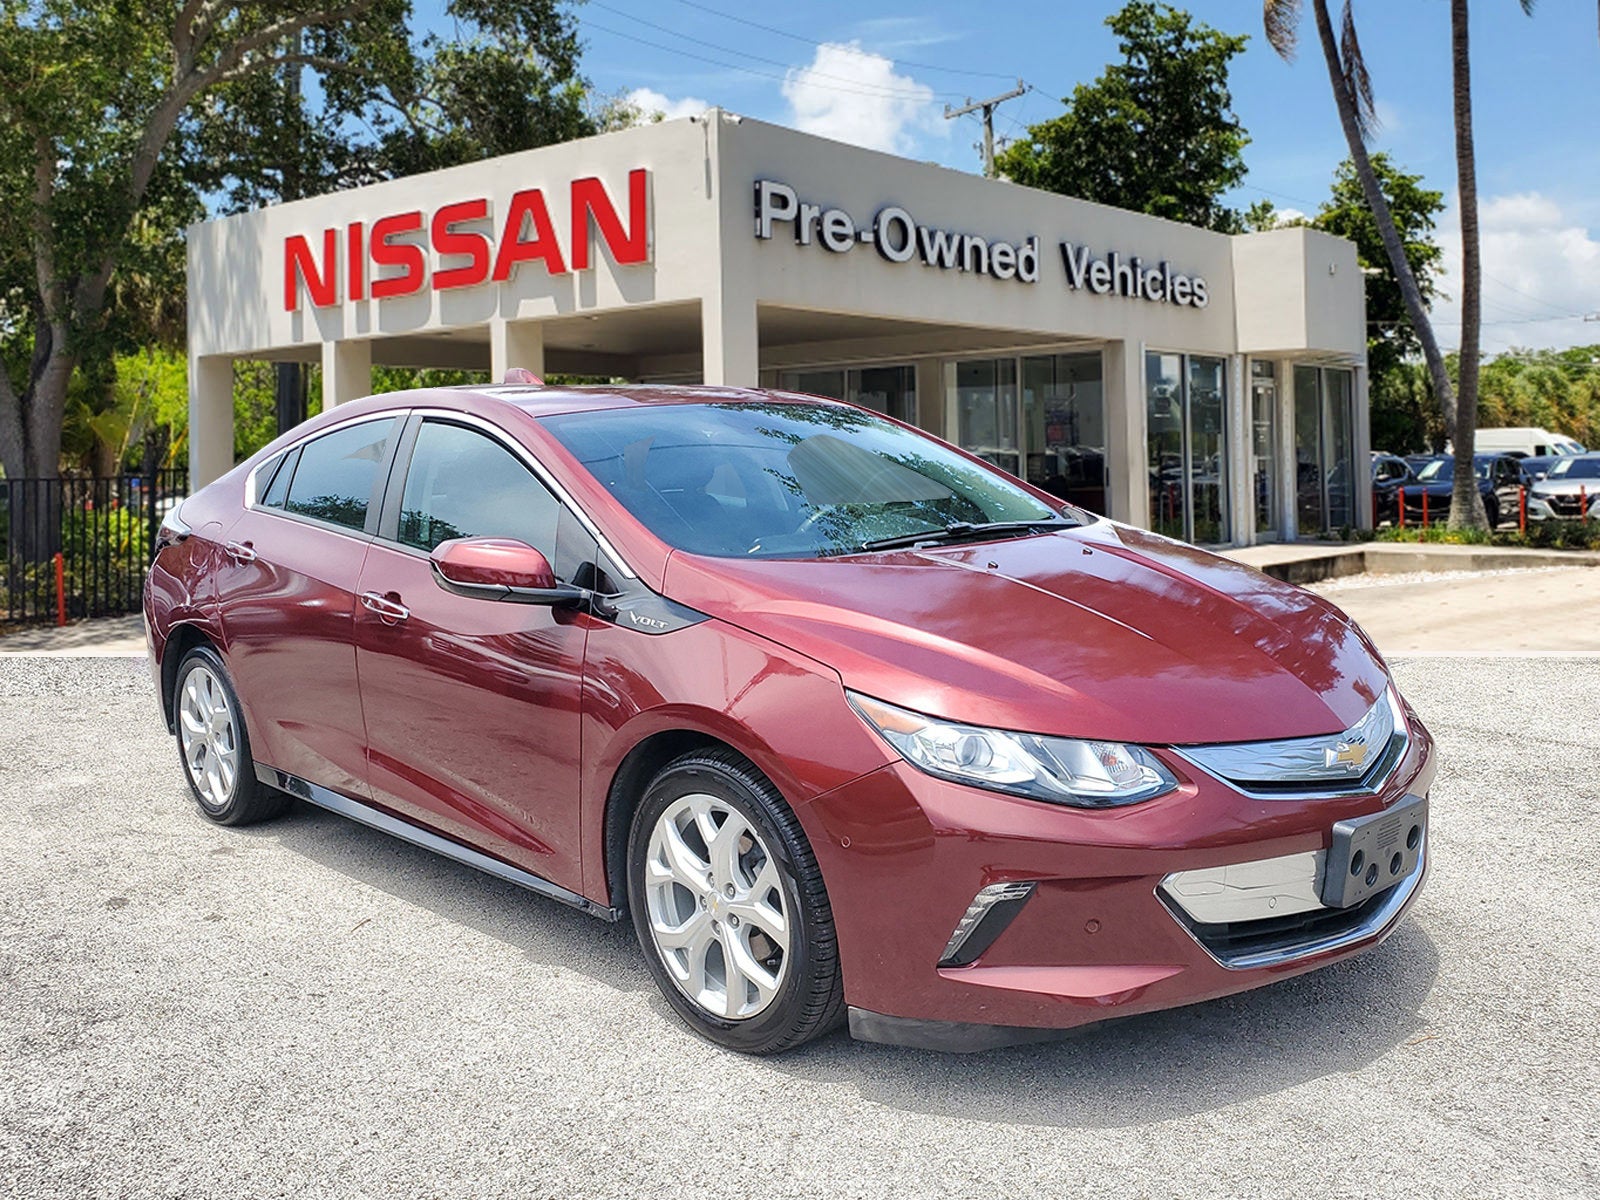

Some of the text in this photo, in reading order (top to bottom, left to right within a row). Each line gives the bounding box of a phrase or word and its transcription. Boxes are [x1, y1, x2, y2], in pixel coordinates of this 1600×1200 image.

[284, 168, 648, 311] NISSAN
[755, 179, 1209, 308] Pre-Owned Vehicles
[629, 610, 669, 629] VOLT
